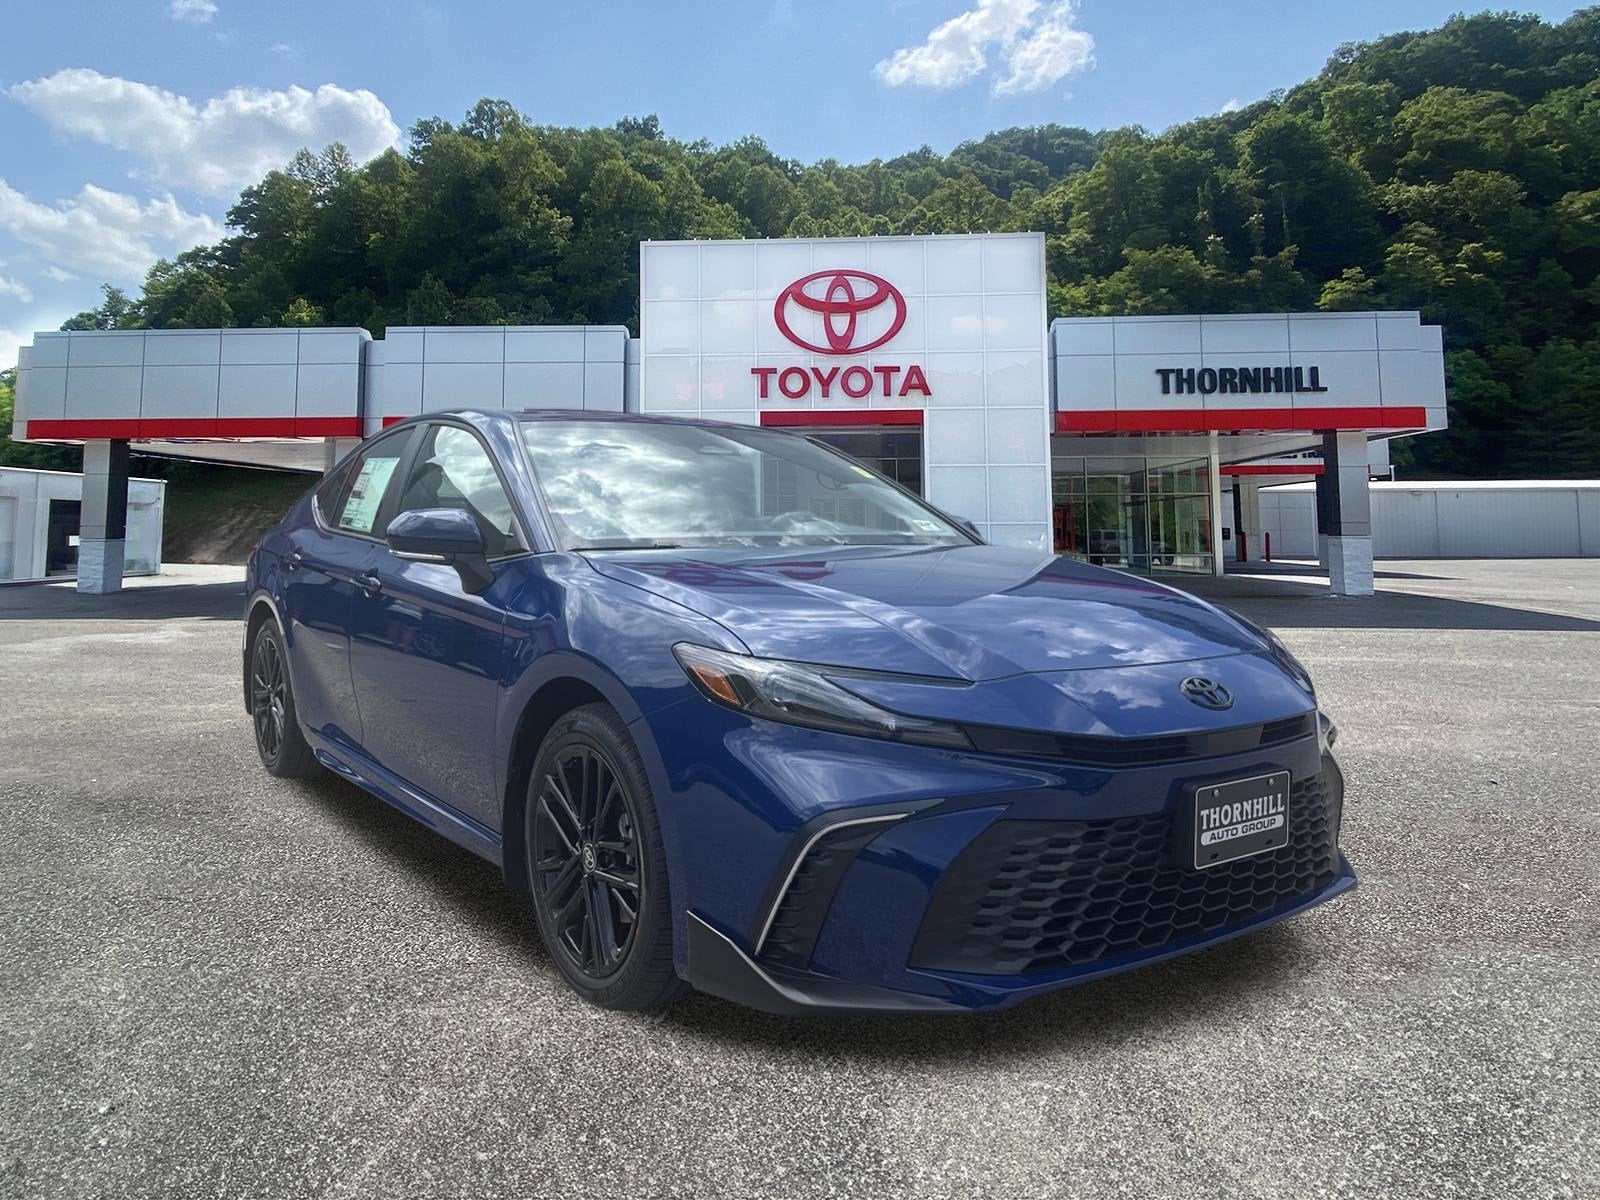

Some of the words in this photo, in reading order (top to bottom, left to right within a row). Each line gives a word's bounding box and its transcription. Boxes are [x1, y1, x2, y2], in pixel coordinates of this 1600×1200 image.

[751, 365, 932, 399] TOYOTA
[1155, 366, 1328, 394] THORNHILL
[1200, 793, 1285, 830] THORNHILL
[1209, 827, 1239, 842] AUTO
[1241, 818, 1277, 835] GROUP
